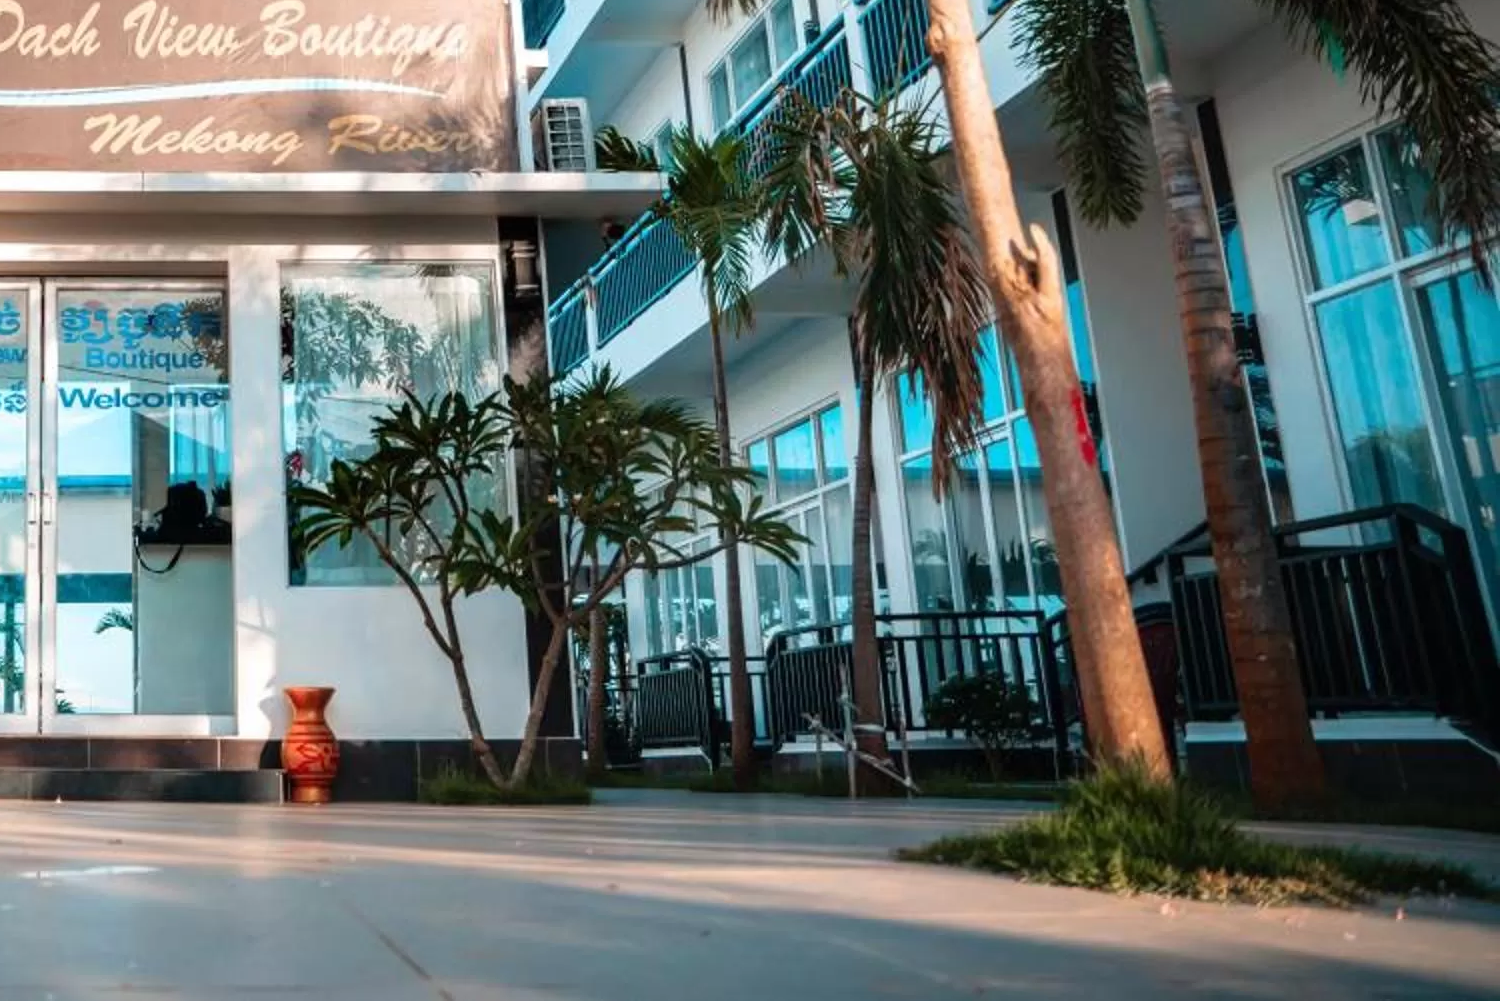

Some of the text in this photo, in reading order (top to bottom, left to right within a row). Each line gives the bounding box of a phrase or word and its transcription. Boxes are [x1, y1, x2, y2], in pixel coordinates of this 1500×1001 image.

[123, 0, 241, 59] View
[260, 0, 469, 76] Boutique
[84, 113, 477, 167] Mekong River
[86, 346, 203, 372] Boutique
[58, 386, 220, 410] Welcome
